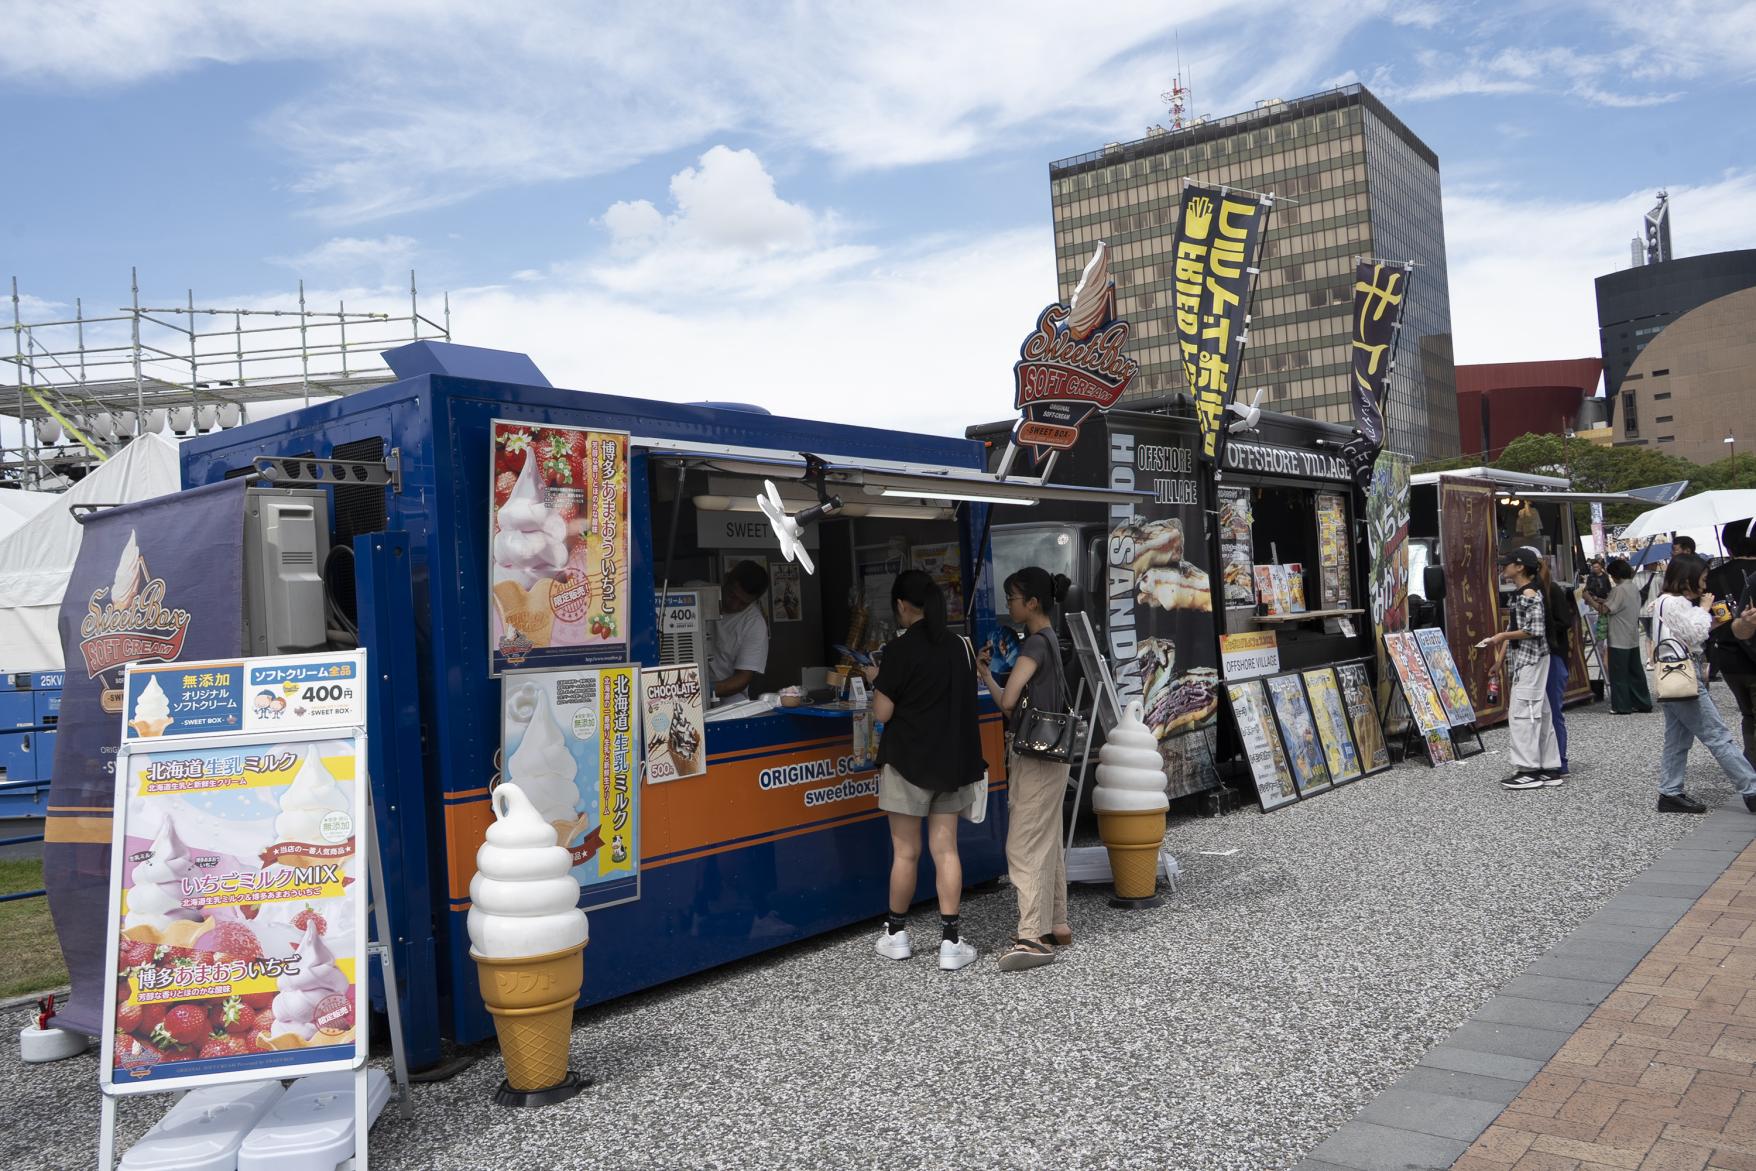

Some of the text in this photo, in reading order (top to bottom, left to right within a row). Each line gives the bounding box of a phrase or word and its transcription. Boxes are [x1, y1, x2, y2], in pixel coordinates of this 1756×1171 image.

[1024, 366, 1114, 403] SOFT CREAM
[1137, 445, 1192, 474] OFFSHORE
[1227, 442, 1298, 477] OFFSHORE
[1302, 453, 1352, 484] VILLAGE
[1154, 479, 1198, 505] VILLAGE
[601, 441, 617, 615] 博多あまおういちご
[726, 522, 768, 537] SWEET
[88, 639, 176, 669] SOFT CREAM
[1226, 654, 1278, 673] OFFSHORE VILLAGE
[183, 673, 231, 690] 無添加
[255, 666, 352, 682] ソフトクリーム全品
[182, 689, 230, 702] オリジナル
[302, 684, 353, 703] 400円
[648, 681, 698, 700] CHOCOLATE
[174, 699, 238, 713] ソフトクリーム
[147, 752, 297, 782] 北海道生乳ミルク
[612, 674, 630, 832] 北海道生乳ミルク
[759, 758, 836, 790] ORIGINAL
[181, 865, 339, 895] いちごミルクMIX
[137, 954, 301, 990] 博多あまおういちご
